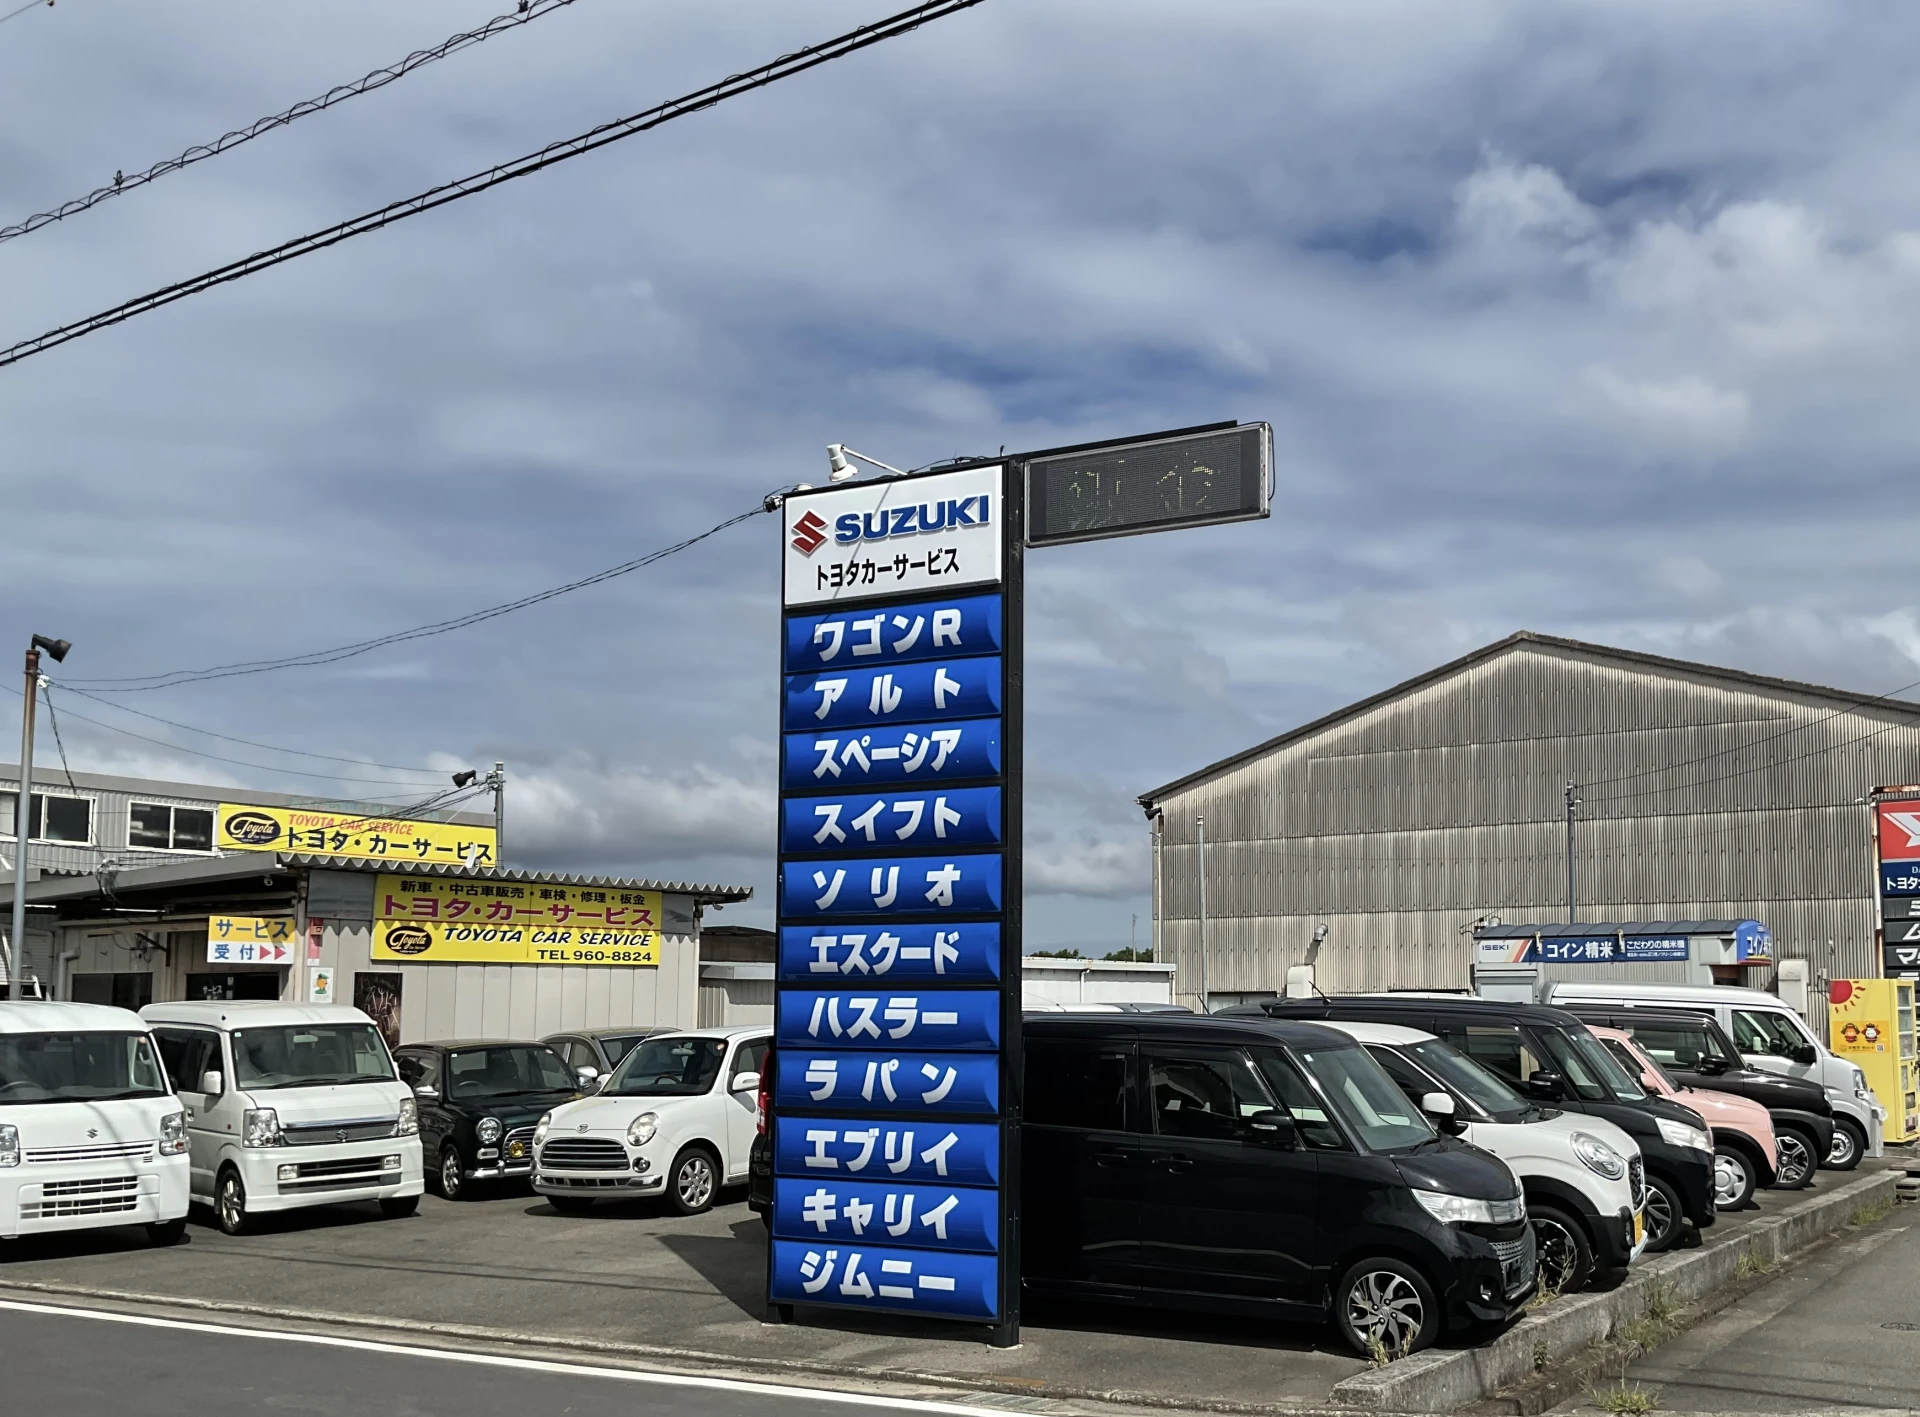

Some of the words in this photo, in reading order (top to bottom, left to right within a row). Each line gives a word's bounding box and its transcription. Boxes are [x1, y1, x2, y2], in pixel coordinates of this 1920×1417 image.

[835, 495, 989, 542] SUZUKI
[818, 548, 960, 590] トヨタカーサービス
[813, 608, 962, 662] ワゴンR
[814, 668, 961, 720] アルト
[813, 729, 962, 779] スペーシア
[230, 816, 275, 838] Toyota
[289, 814, 335, 828] TOYOTA
[339, 819, 364, 831] CAR
[368, 821, 414, 835] SERVICE
[813, 797, 962, 844] スイフト
[288, 826, 492, 861] トヨタ・カーサービス
[812, 864, 961, 910] ソリオ
[216, 919, 289, 938] サービス
[384, 894, 655, 926] トヨタ・カーサービス
[214, 944, 255, 960] 受付
[389, 930, 427, 949] Toyota
[444, 928, 523, 942] TOYOTA
[531, 930, 572, 944] CAR
[578, 933, 652, 946] SERVICE
[537, 950, 570, 960] TEL
[573, 950, 652, 961] 960-8824
[809, 931, 960, 976] エスクード
[1546, 941, 1614, 959] コイン精米
[808, 996, 958, 1040] ハスラー
[805, 1059, 957, 1104] ラパン
[804, 1127, 959, 1176] エブリイ
[802, 1188, 959, 1240] キャリイ
[799, 1250, 955, 1299] ジムニー
